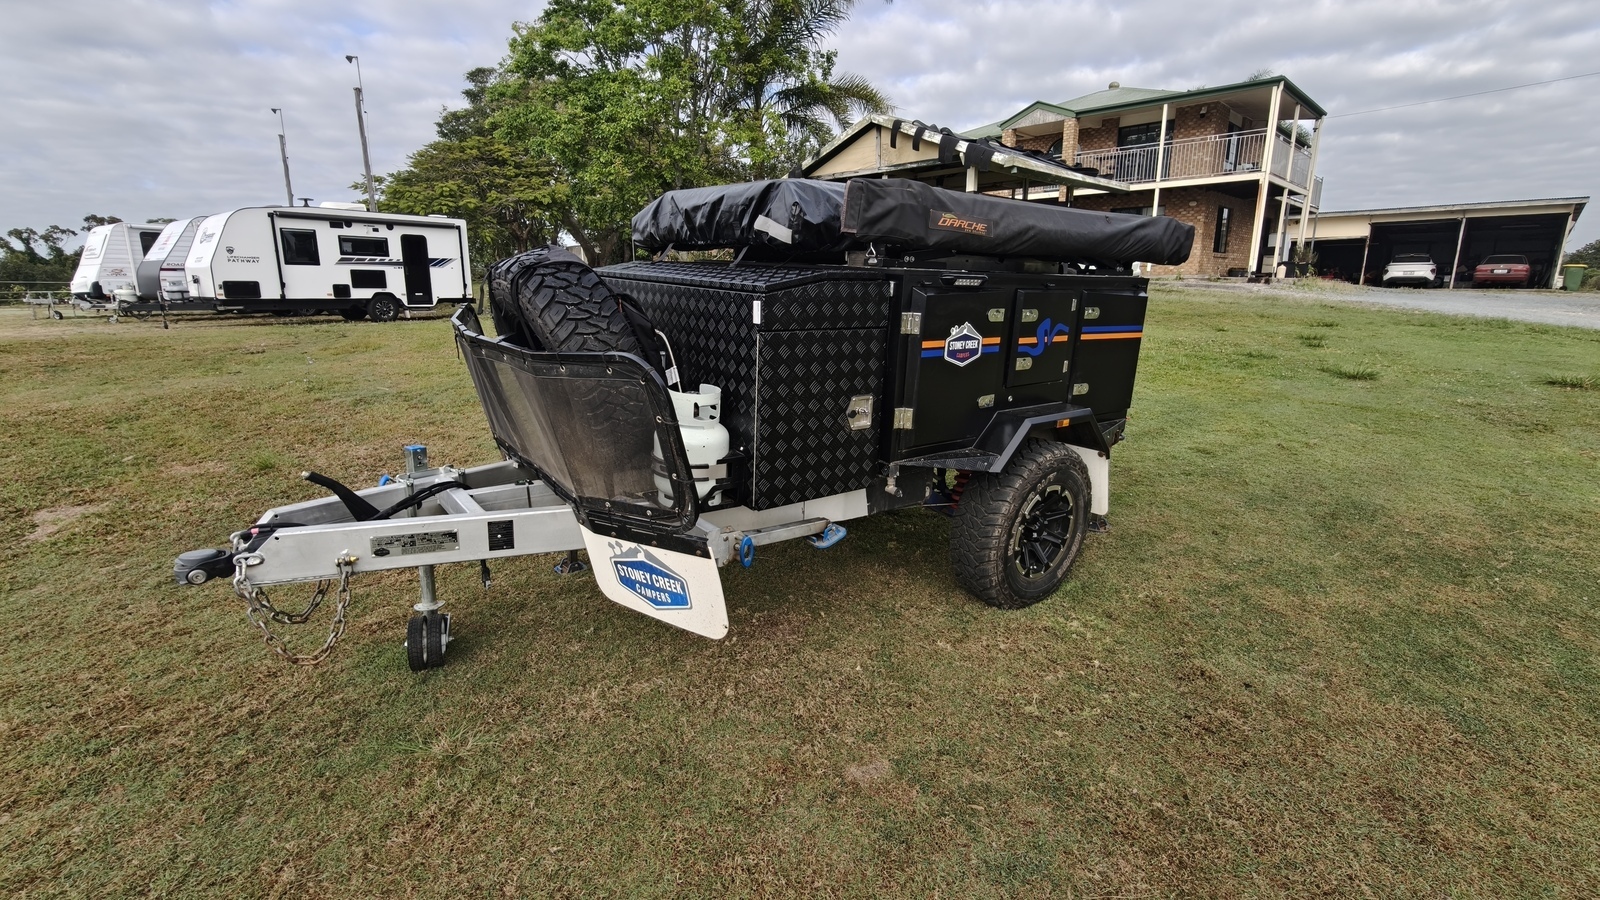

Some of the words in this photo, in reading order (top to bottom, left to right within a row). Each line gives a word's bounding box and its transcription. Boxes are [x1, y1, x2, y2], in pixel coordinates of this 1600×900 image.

[937, 217, 988, 232] DARCHE
[949, 341, 966, 350] STONEY
[965, 340, 979, 349] CREEK
[617, 563, 652, 585] STONEY
[652, 574, 684, 595] CREEK
[635, 583, 672, 603] CAMPERS
